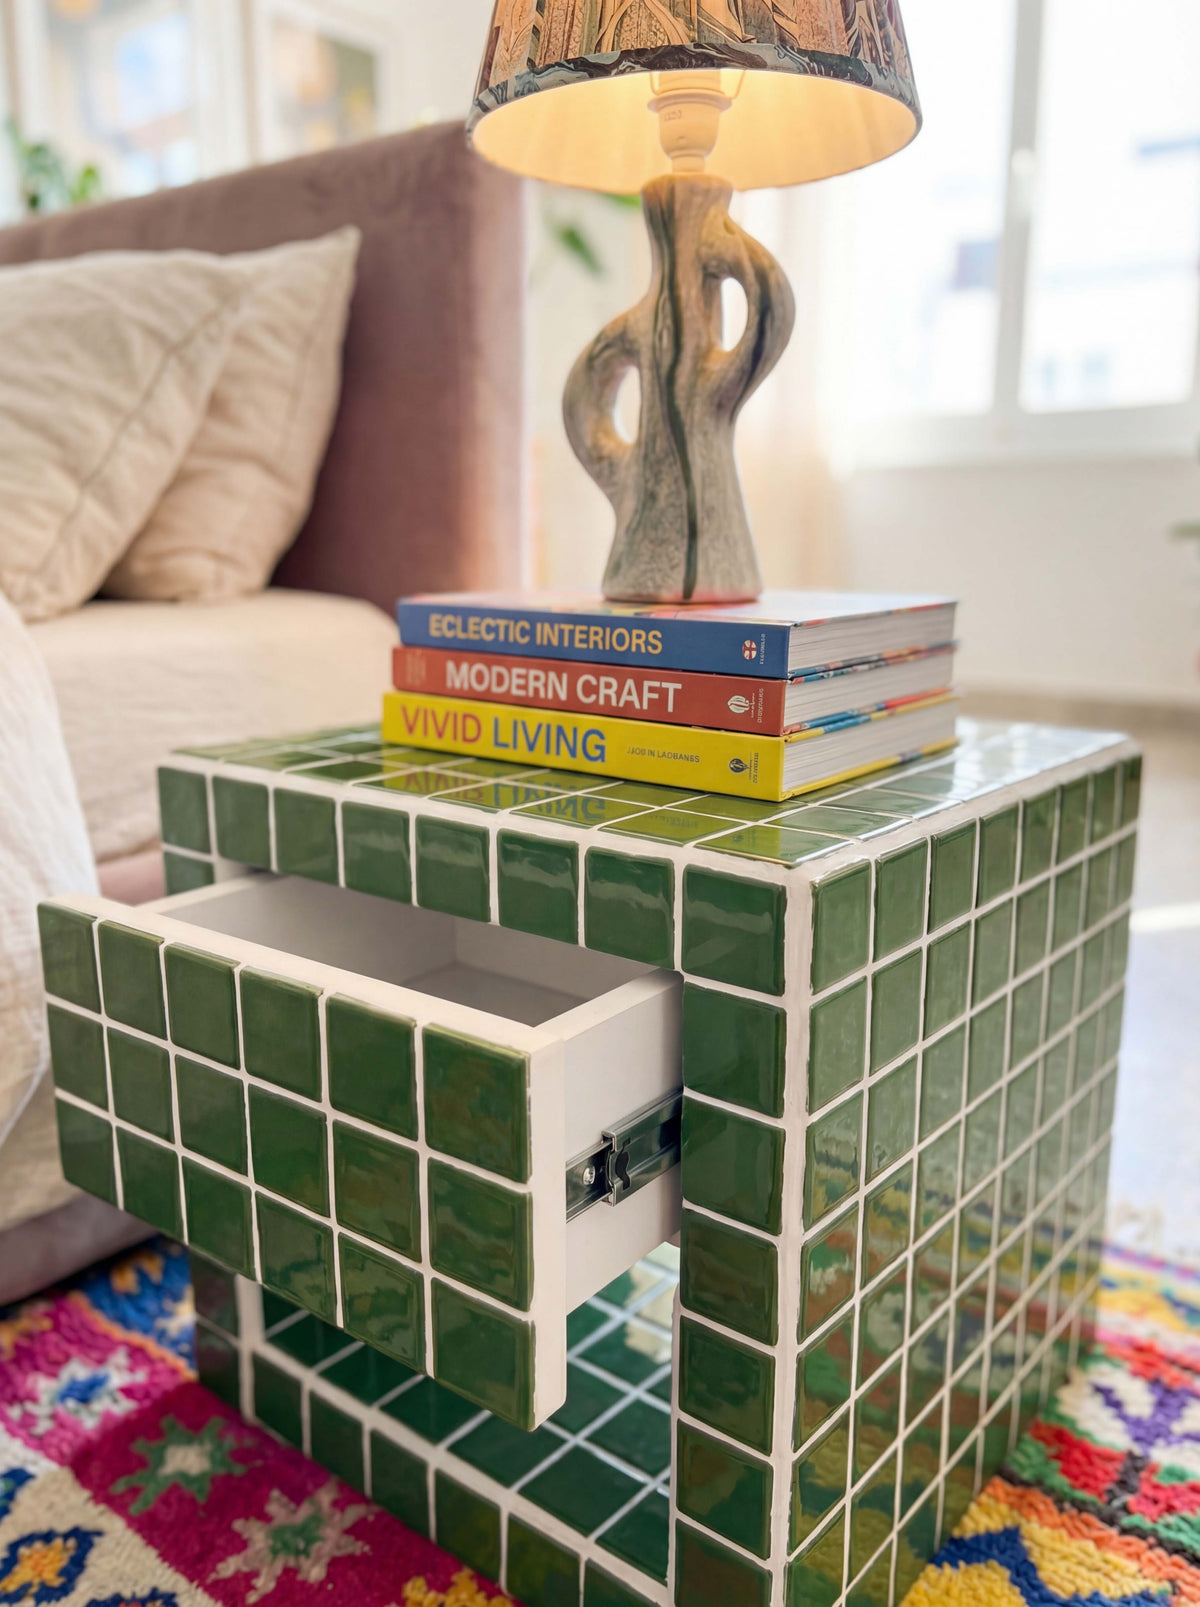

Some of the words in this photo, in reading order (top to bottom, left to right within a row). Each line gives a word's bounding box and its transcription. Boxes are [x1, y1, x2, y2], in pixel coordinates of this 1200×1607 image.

[429, 613, 531, 644] ECLECTIC
[535, 622, 663, 655] INTERIORS
[446, 660, 568, 701] MODERN
[576, 673, 682, 713] CRAFT
[401, 705, 483, 744] VIVID
[492, 717, 606, 763] LIVING
